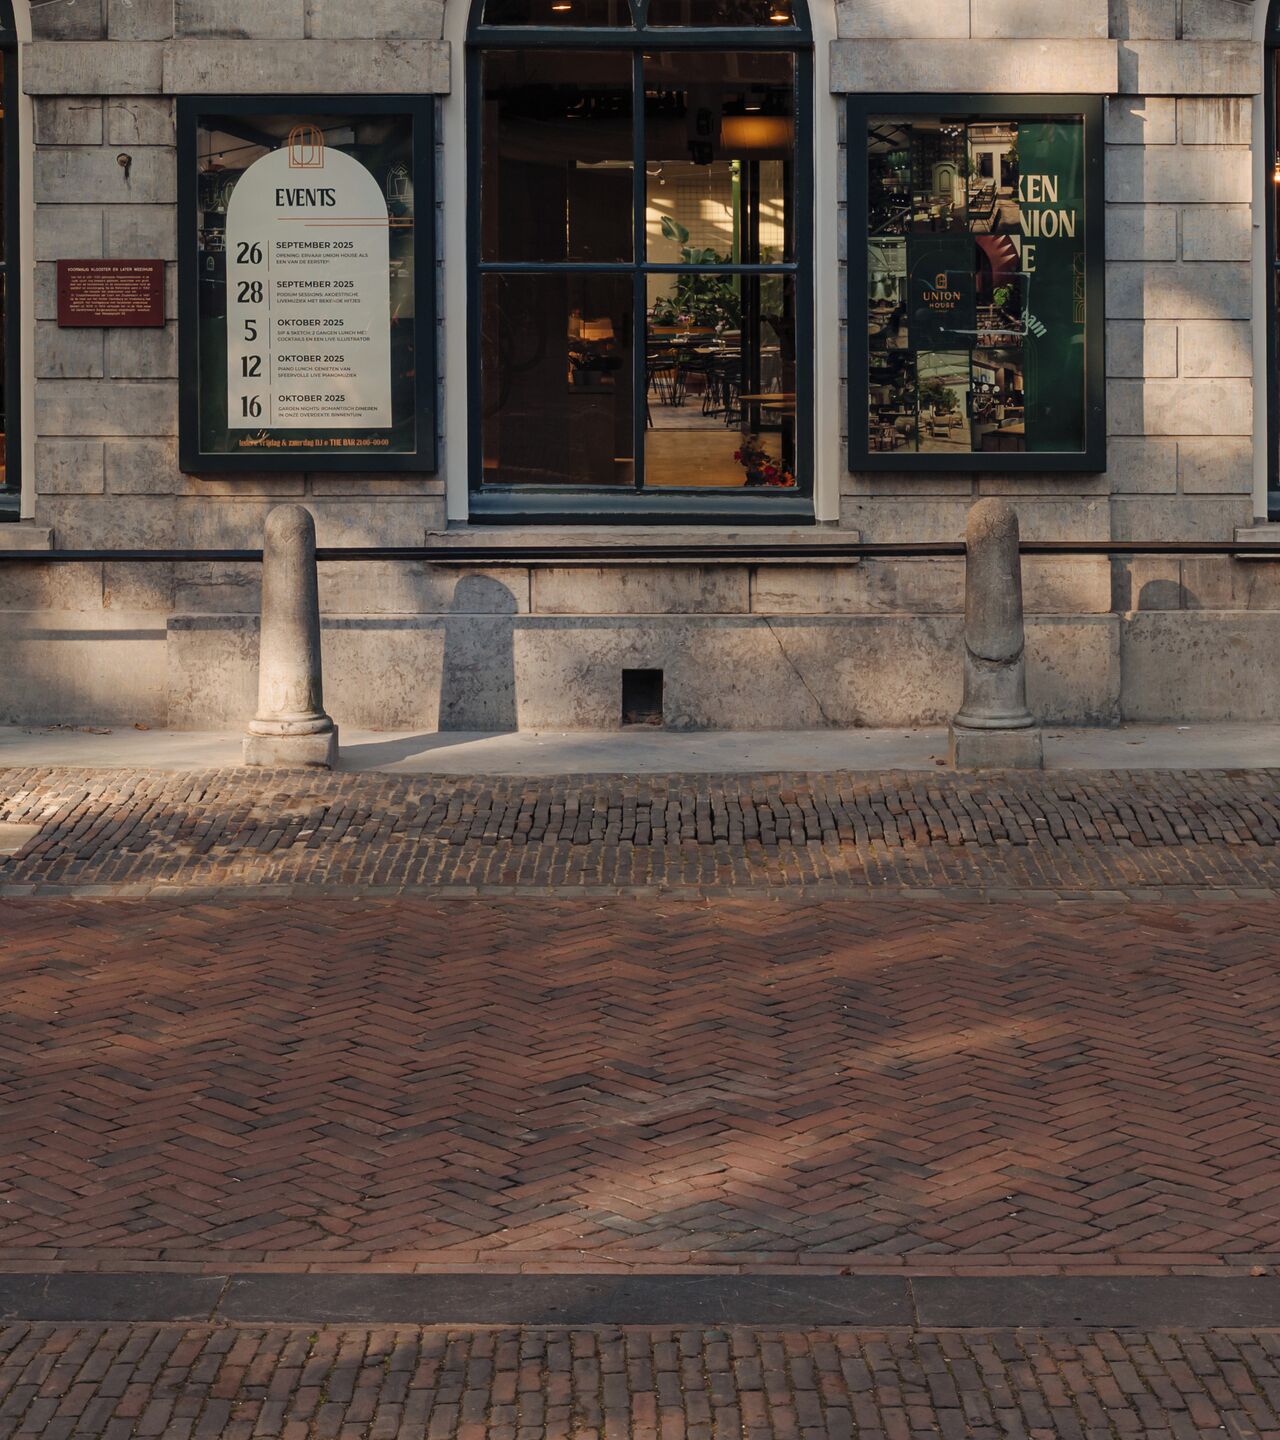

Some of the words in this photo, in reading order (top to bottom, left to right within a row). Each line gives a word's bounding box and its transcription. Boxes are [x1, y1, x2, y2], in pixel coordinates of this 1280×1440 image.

[275, 189, 336, 206] EVENTS
[236, 242, 263, 264] 26
[237, 281, 263, 303] 28
[923, 292, 960, 301] UNION
[244, 320, 257, 342] 5
[241, 355, 261, 377] 12
[241, 395, 262, 417] 16
